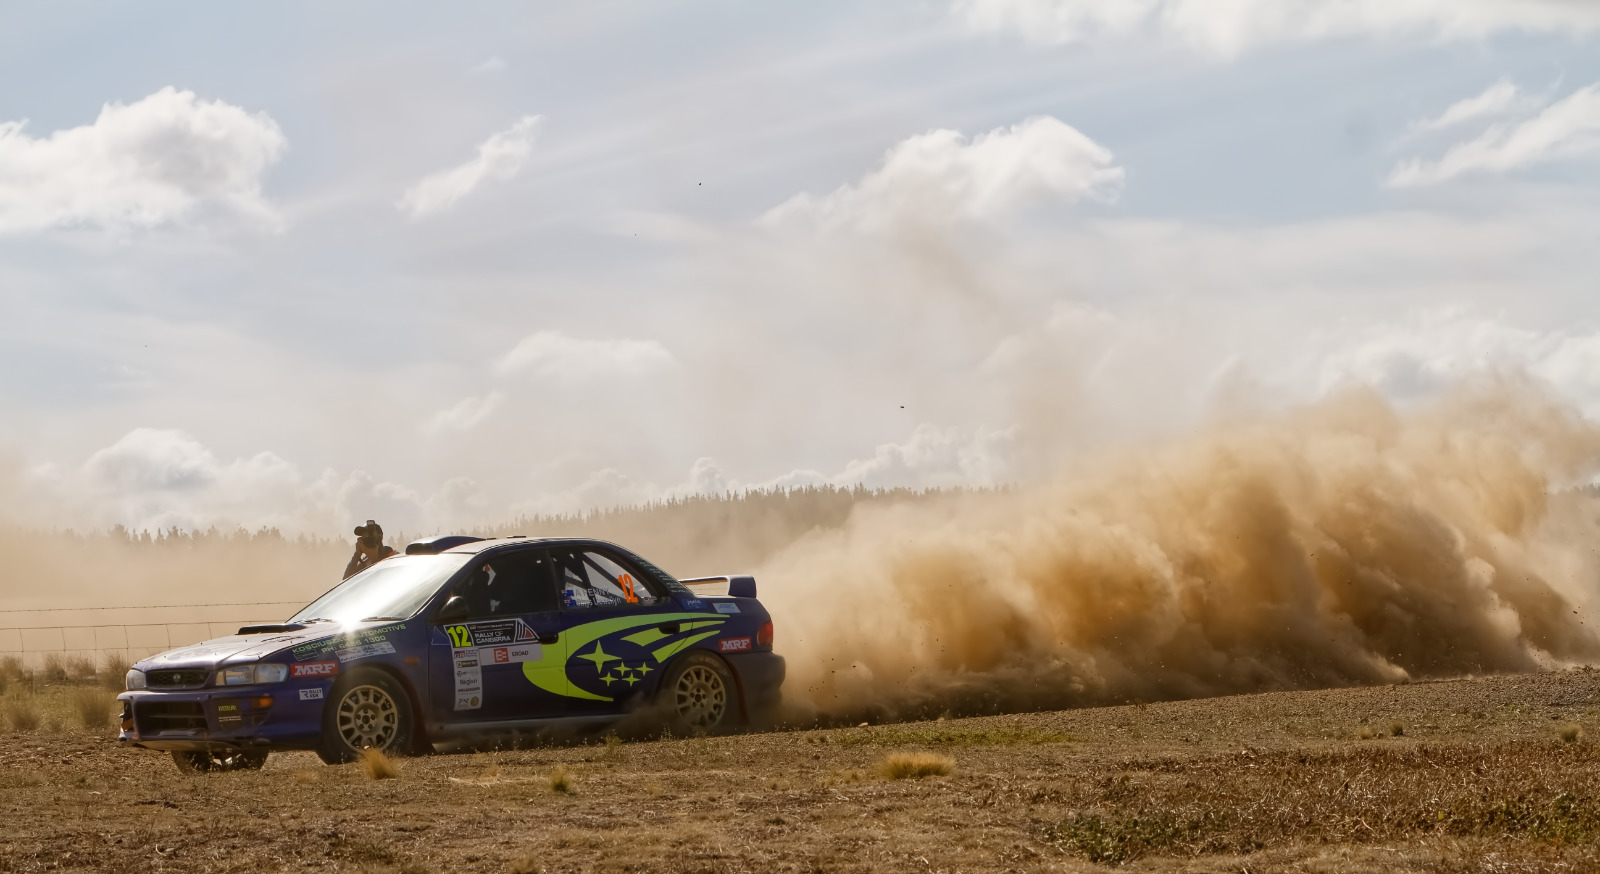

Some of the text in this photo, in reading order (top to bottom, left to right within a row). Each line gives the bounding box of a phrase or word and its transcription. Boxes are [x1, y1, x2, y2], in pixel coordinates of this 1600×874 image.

[617, 573, 639, 604] 12
[353, 623, 406, 640] AUTOMOTIVE
[447, 625, 472, 648] 12
[476, 636, 511, 644] CANBERRA
[321, 645, 337, 653] PH:
[364, 635, 387, 644] 1300
[722, 639, 750, 651] MRF
[294, 663, 336, 676] MRF
